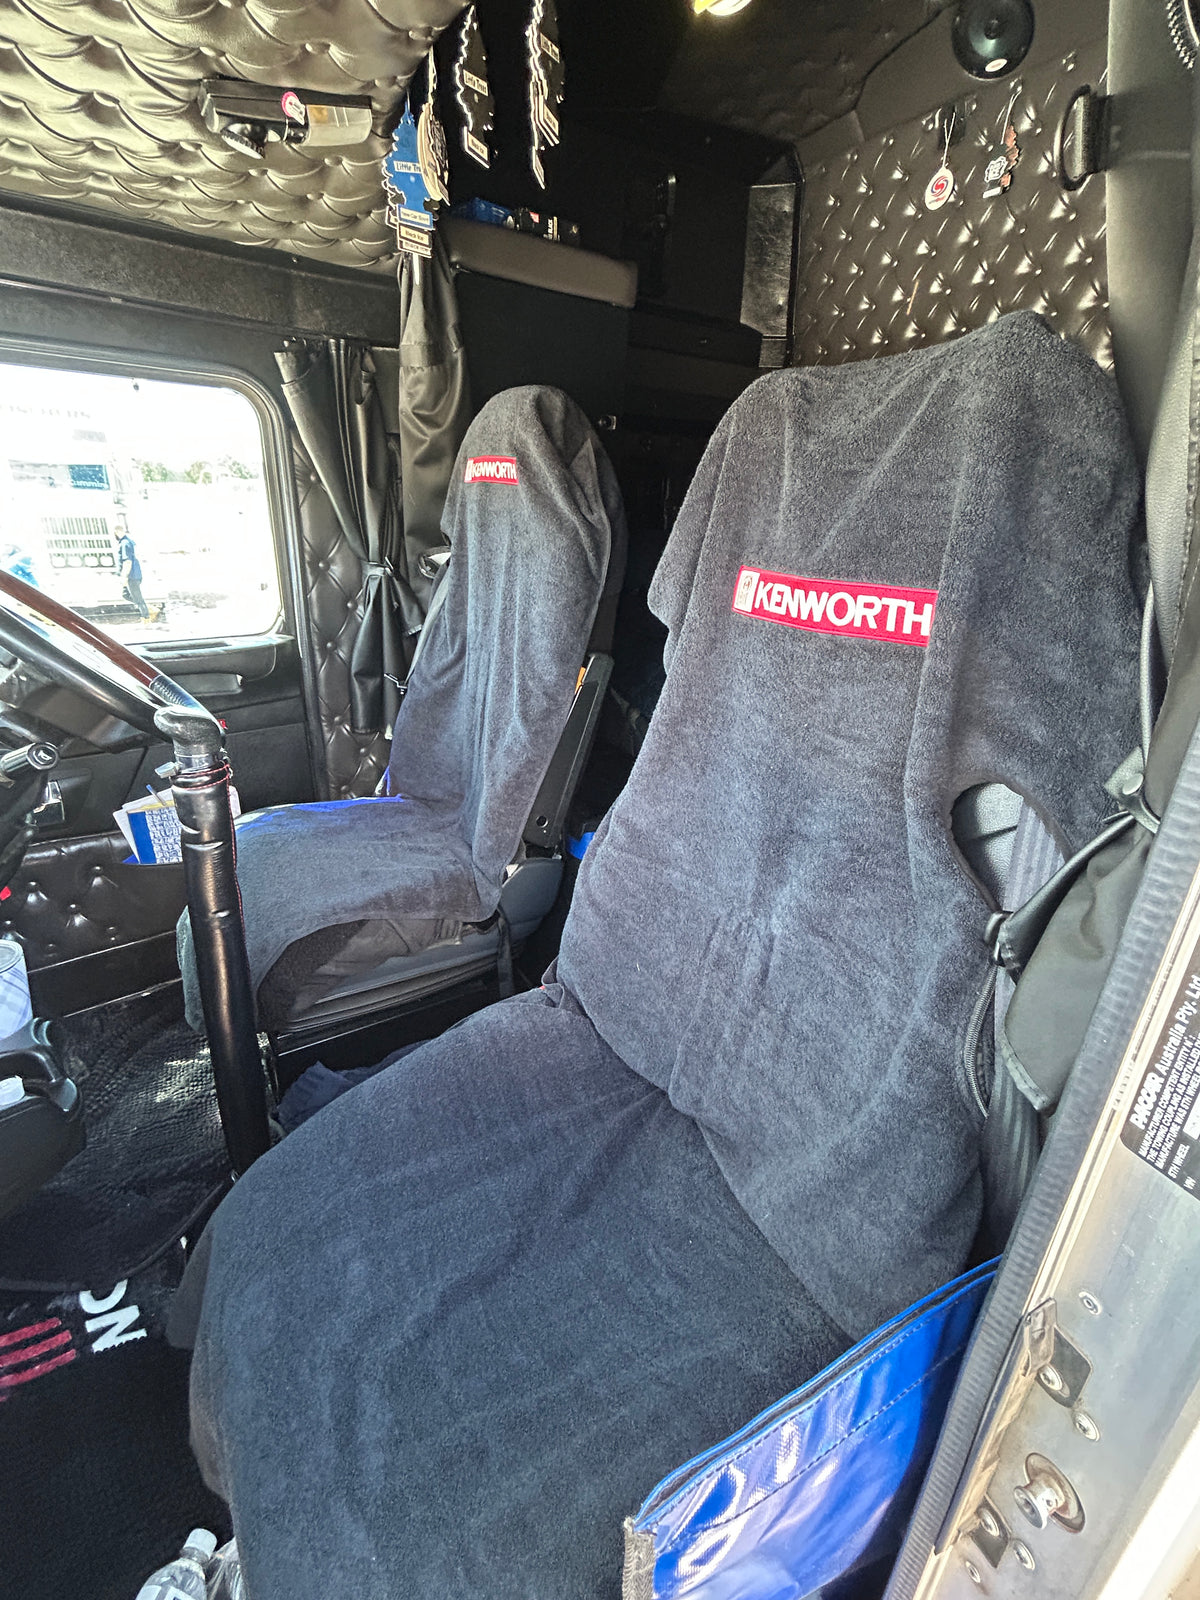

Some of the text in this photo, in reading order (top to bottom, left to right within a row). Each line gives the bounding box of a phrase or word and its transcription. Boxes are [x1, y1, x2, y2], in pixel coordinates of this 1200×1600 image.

[396, 162, 412, 171] Little
[472, 460, 517, 480] KENWORTH
[754, 580, 934, 637] KENWORTH
[1129, 1071, 1165, 1130] PACCAR
[1155, 1023, 1187, 1076] Australia
[1174, 1000, 1197, 1024] Pty.
[1138, 1107, 1165, 1158] MANUFACTURER
[1158, 1069, 1180, 1110] COMPETENT
[1173, 1045, 1190, 1071] ENTITY
[1146, 1149, 1158, 1163] THE
[1152, 1124, 1168, 1148] TOWING
[1162, 1092, 1181, 1126] COUPLING
[1175, 1082, 1186, 1096] AS
[1154, 1121, 1180, 1170] MANUFACTURE
[1173, 1107, 1187, 1125] WAS
[1172, 1143, 1190, 1167] WHEEL
